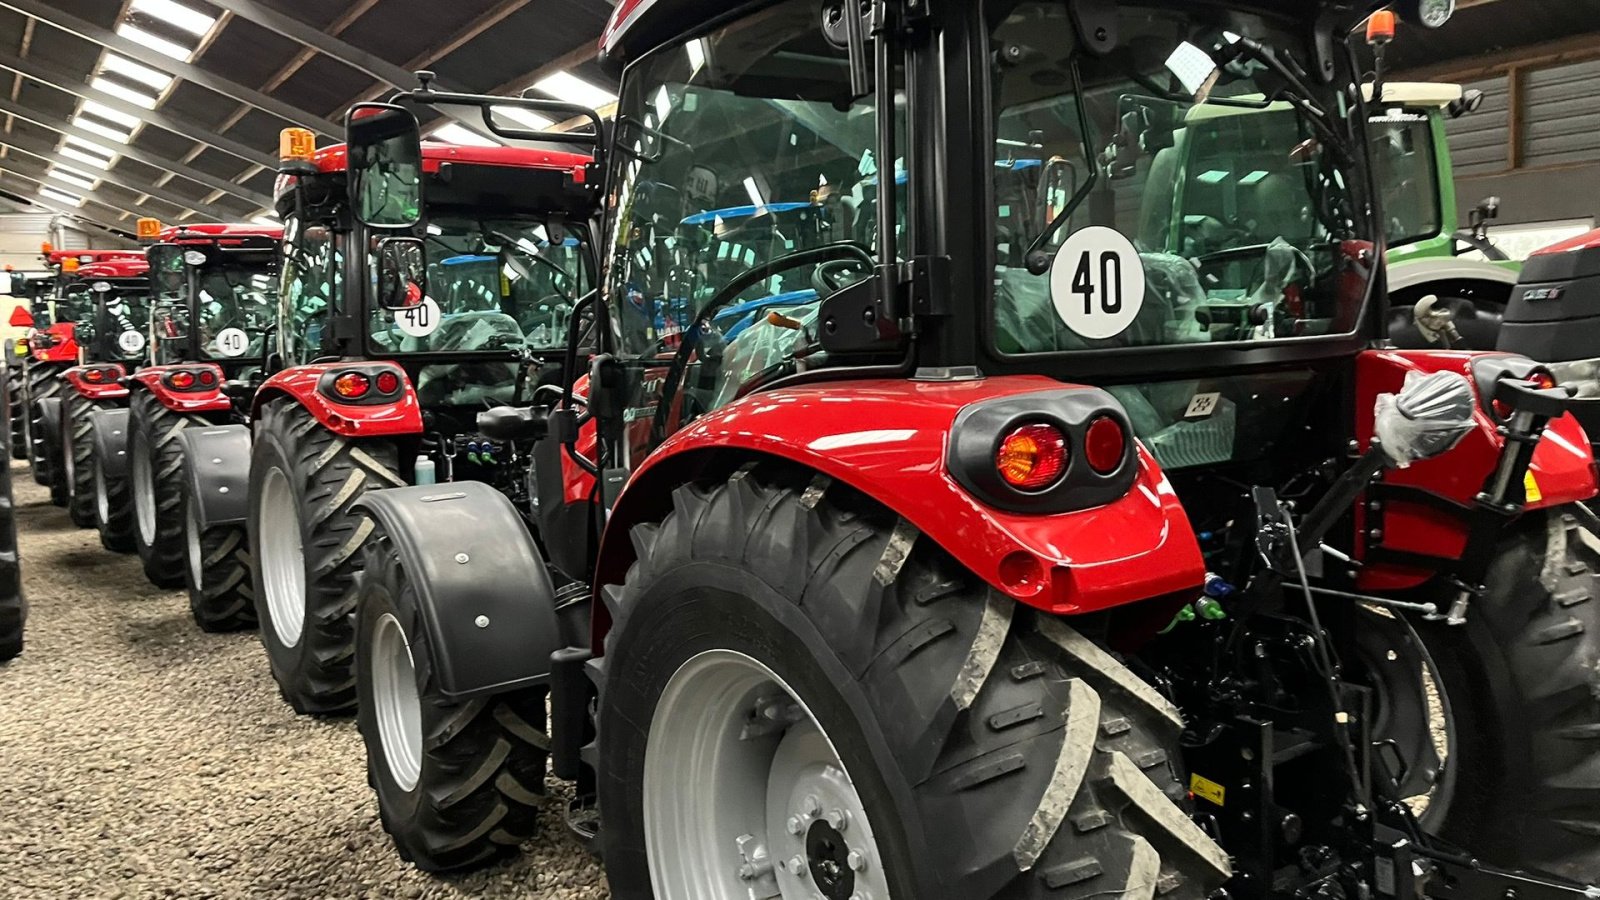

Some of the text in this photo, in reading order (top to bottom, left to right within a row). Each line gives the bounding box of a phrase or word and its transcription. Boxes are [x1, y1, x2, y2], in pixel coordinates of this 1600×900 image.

[1071, 250, 1122, 315] 40
[405, 303, 428, 327] 40
[125, 334, 139, 347] 40
[224, 334, 240, 350] 40
